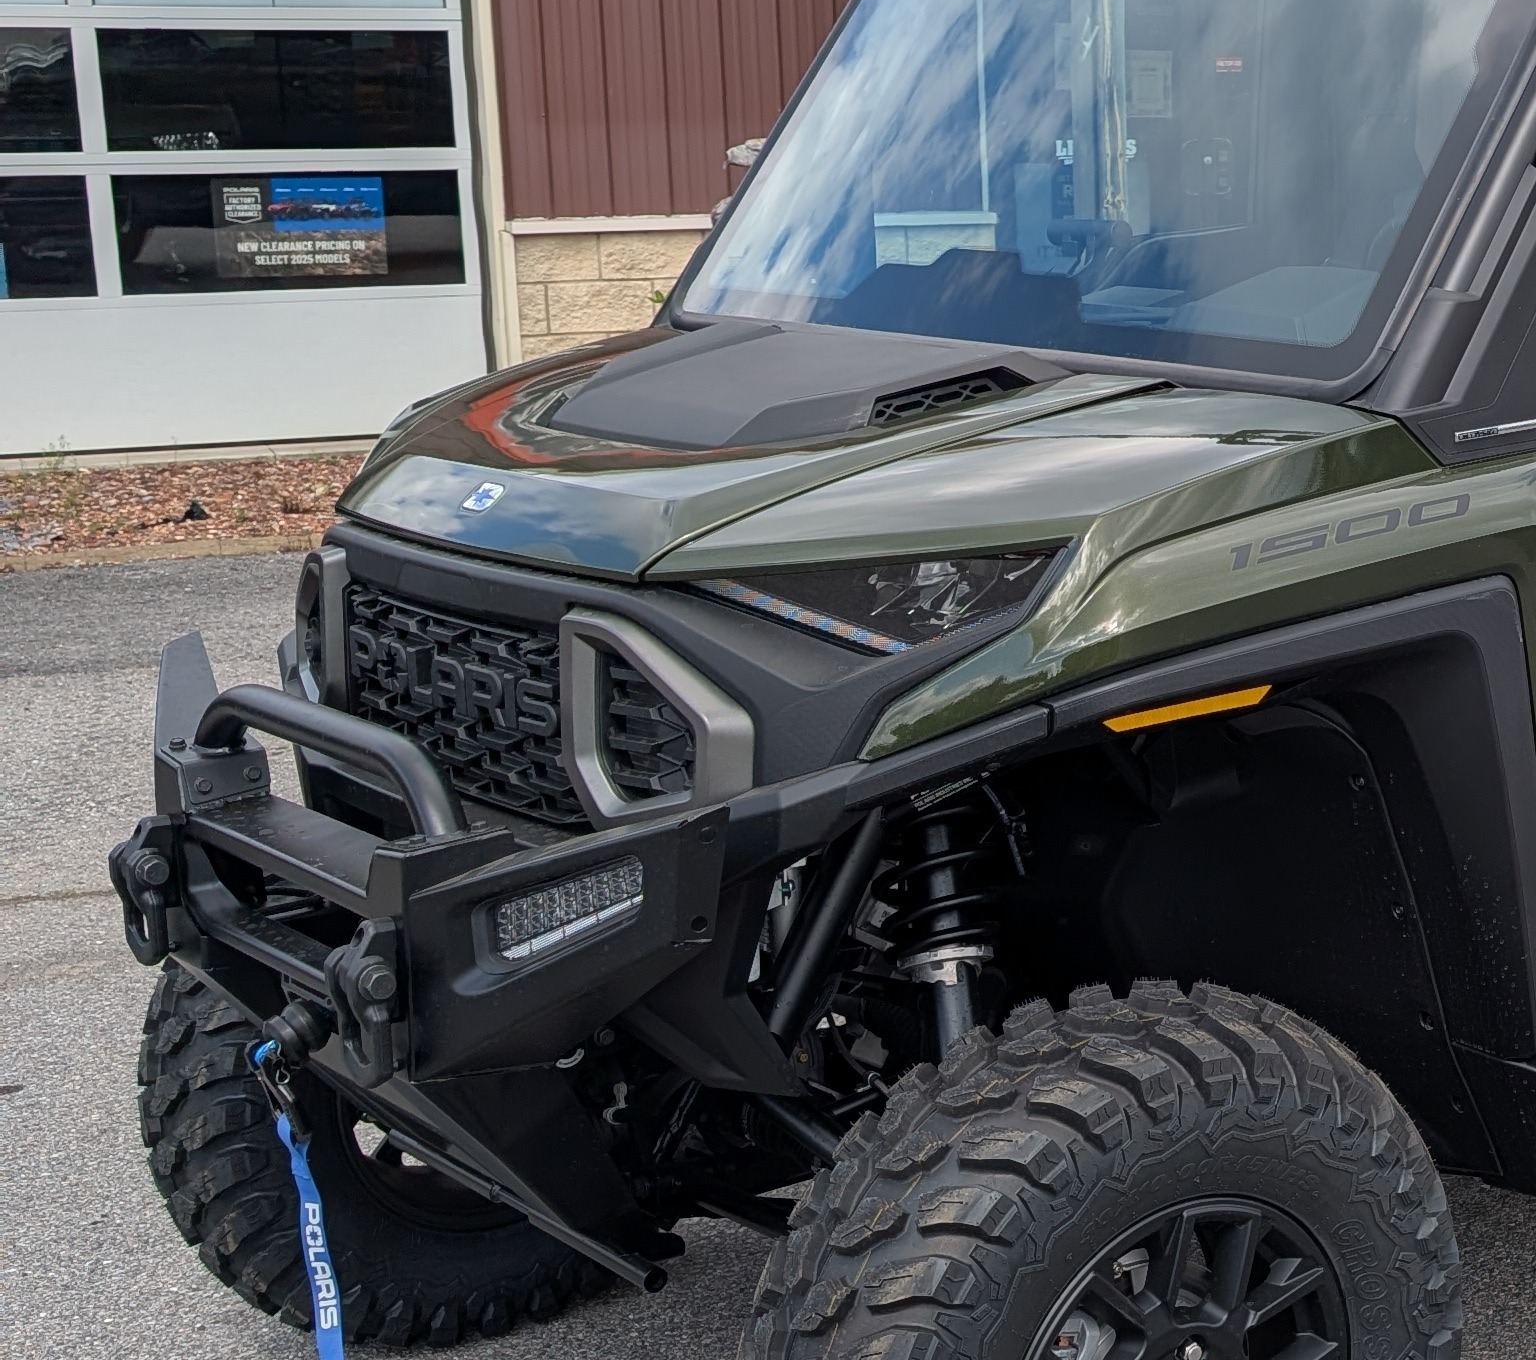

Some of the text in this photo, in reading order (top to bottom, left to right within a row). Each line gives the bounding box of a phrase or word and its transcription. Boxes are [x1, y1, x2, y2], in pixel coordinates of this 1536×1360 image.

[237, 240, 365, 252] NEW CLEARANCE PRICING ON
[255, 253, 350, 265] SELECT 2025 MODELS
[1230, 493, 1471, 571] 1500
[350, 625, 557, 737] POLARIS
[304, 1202, 339, 1330] POLARIS
